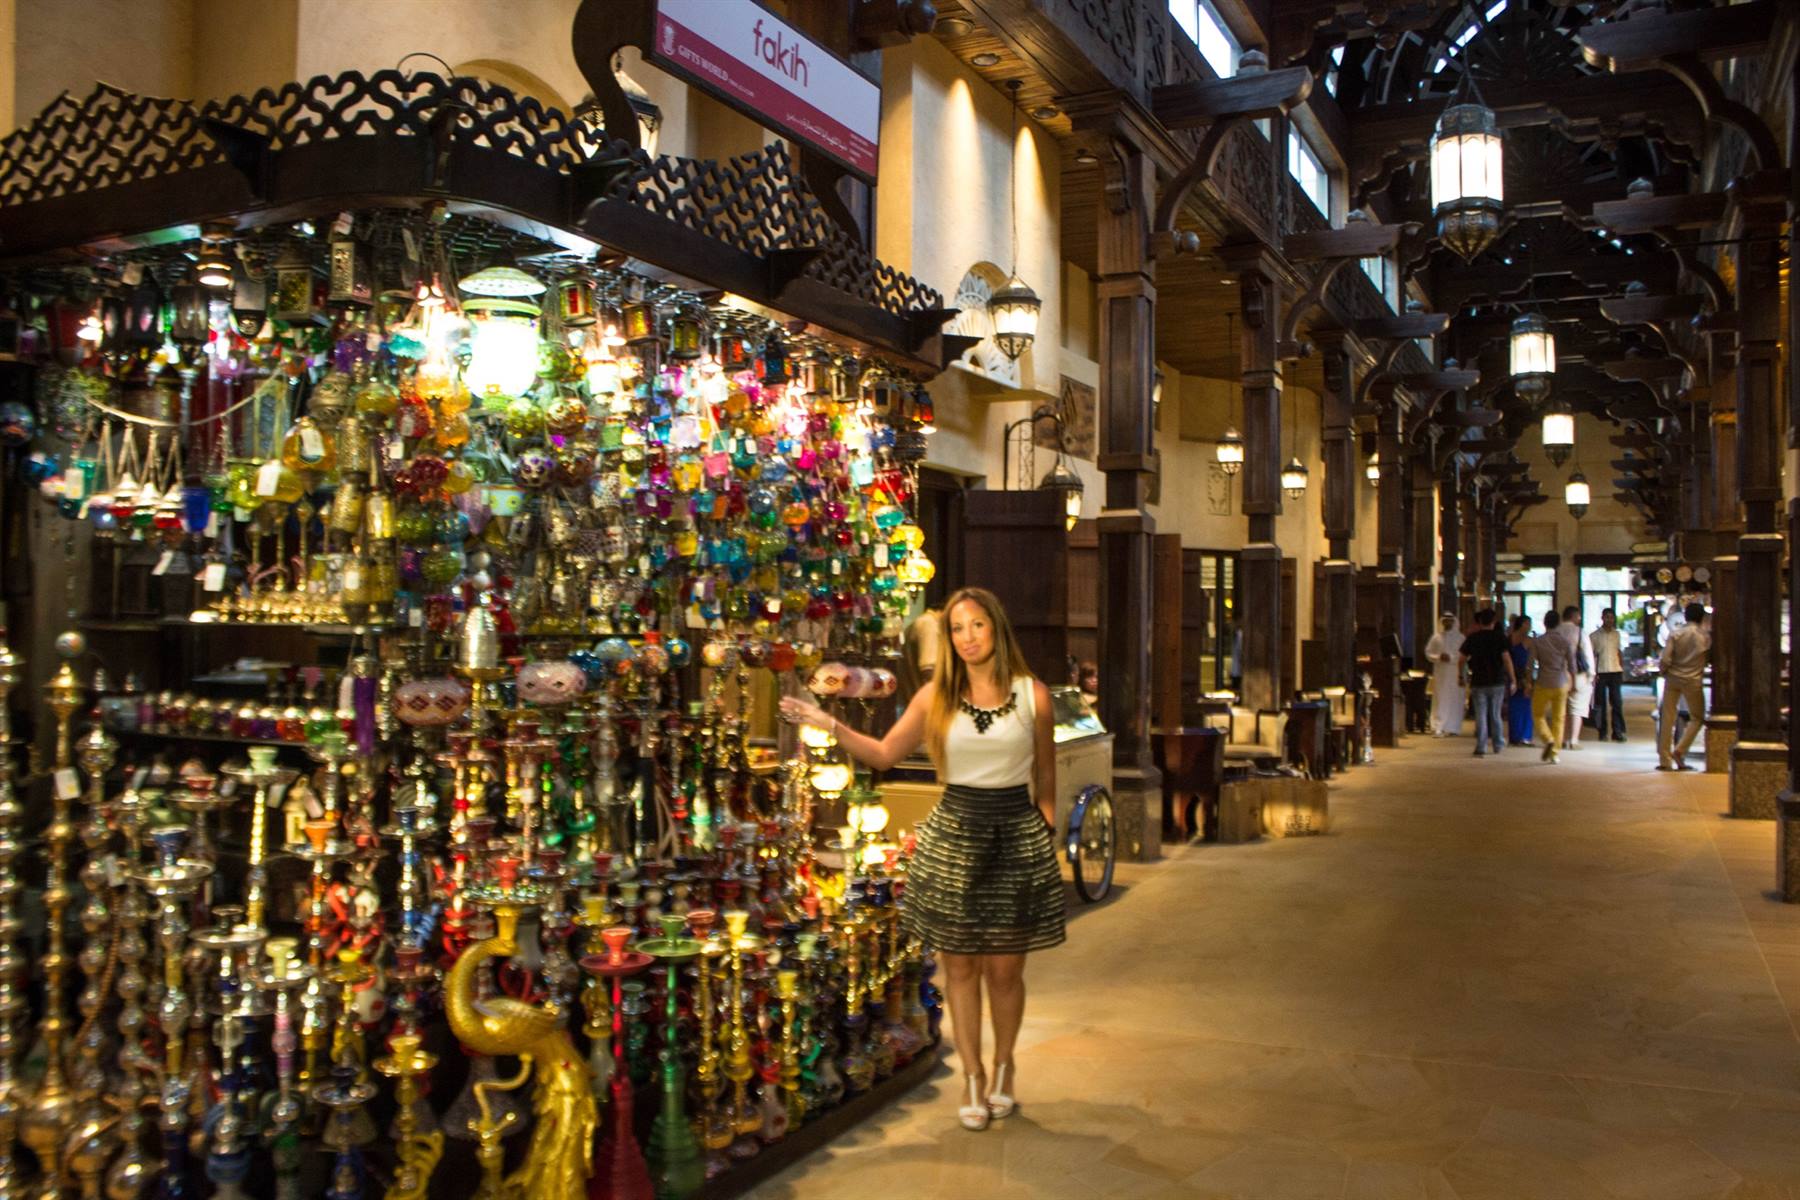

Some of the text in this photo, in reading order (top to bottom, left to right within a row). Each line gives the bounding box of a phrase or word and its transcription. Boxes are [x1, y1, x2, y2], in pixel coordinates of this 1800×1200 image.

[678, 44, 728, 81] GIFTS WORLD
[753, 19, 808, 87] fakih
